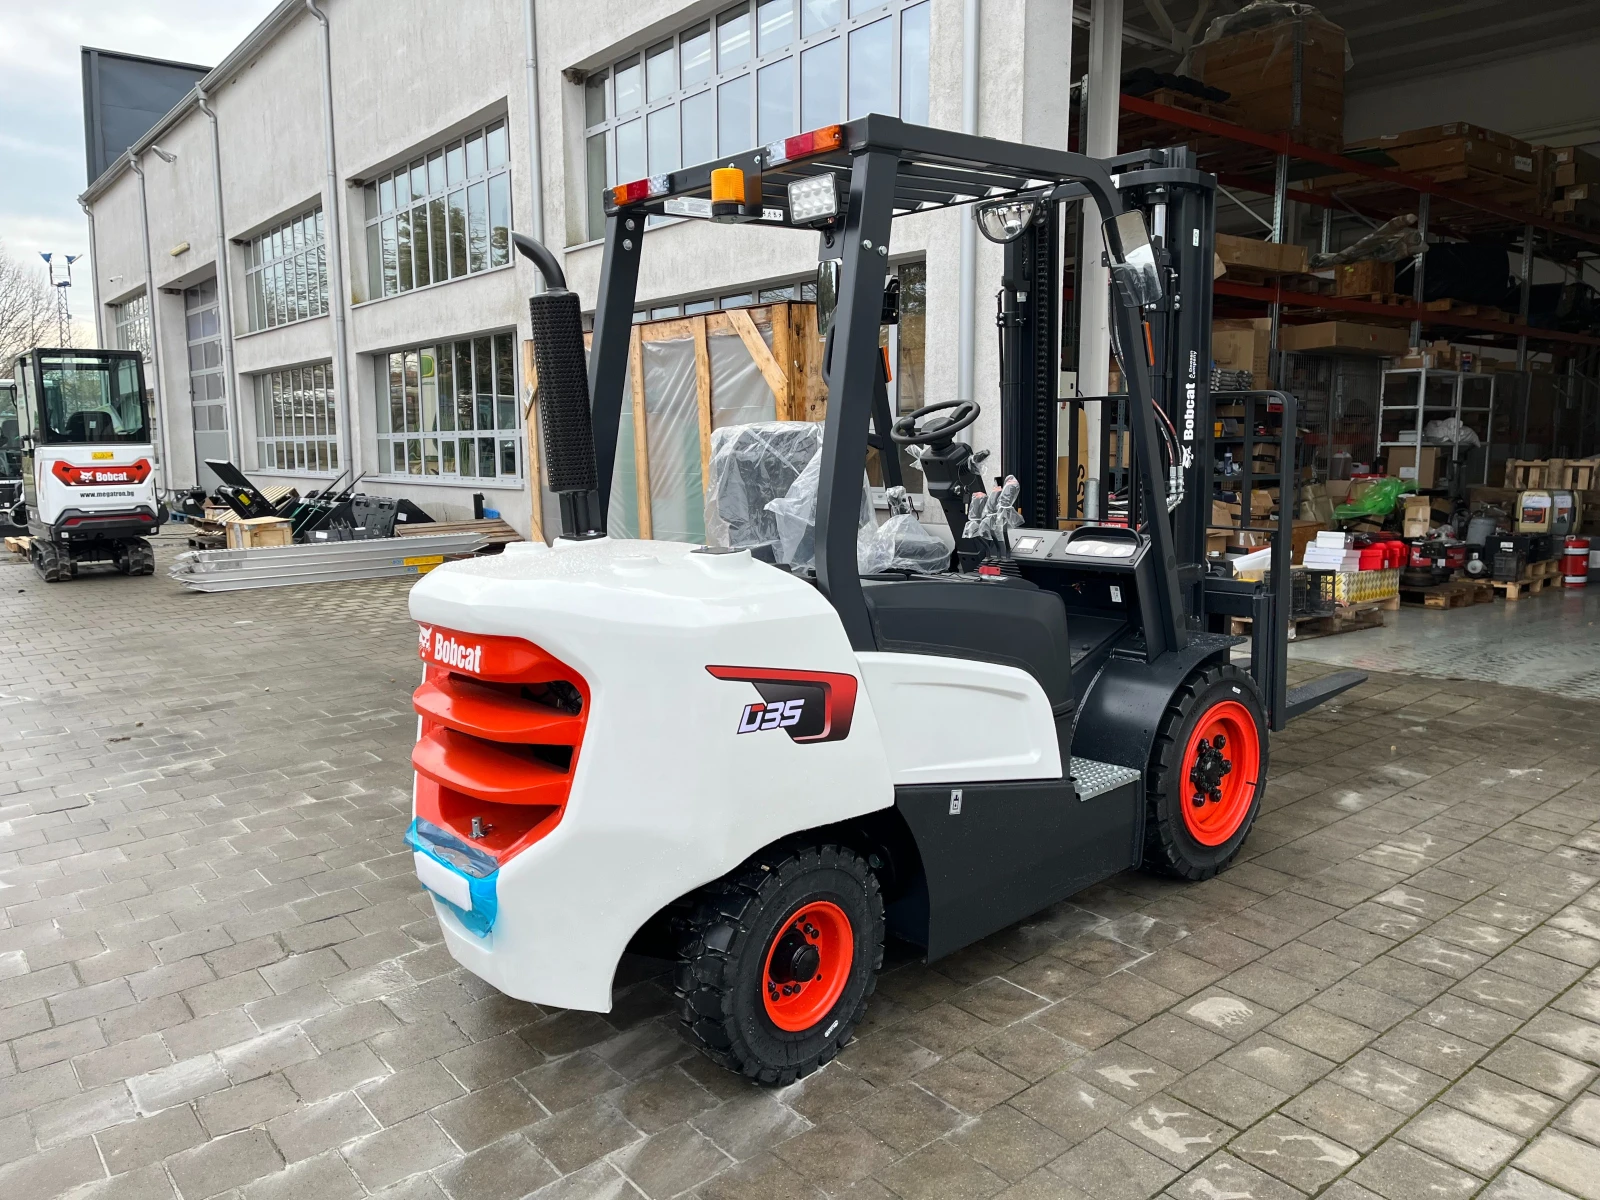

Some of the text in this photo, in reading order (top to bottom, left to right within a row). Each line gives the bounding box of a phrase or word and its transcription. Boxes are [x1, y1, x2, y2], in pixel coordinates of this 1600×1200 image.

[1183, 382, 1196, 440] Bobcat
[95, 471, 128, 482] Bobcat
[434, 632, 482, 673] Bobcat
[737, 699, 805, 734] D35
